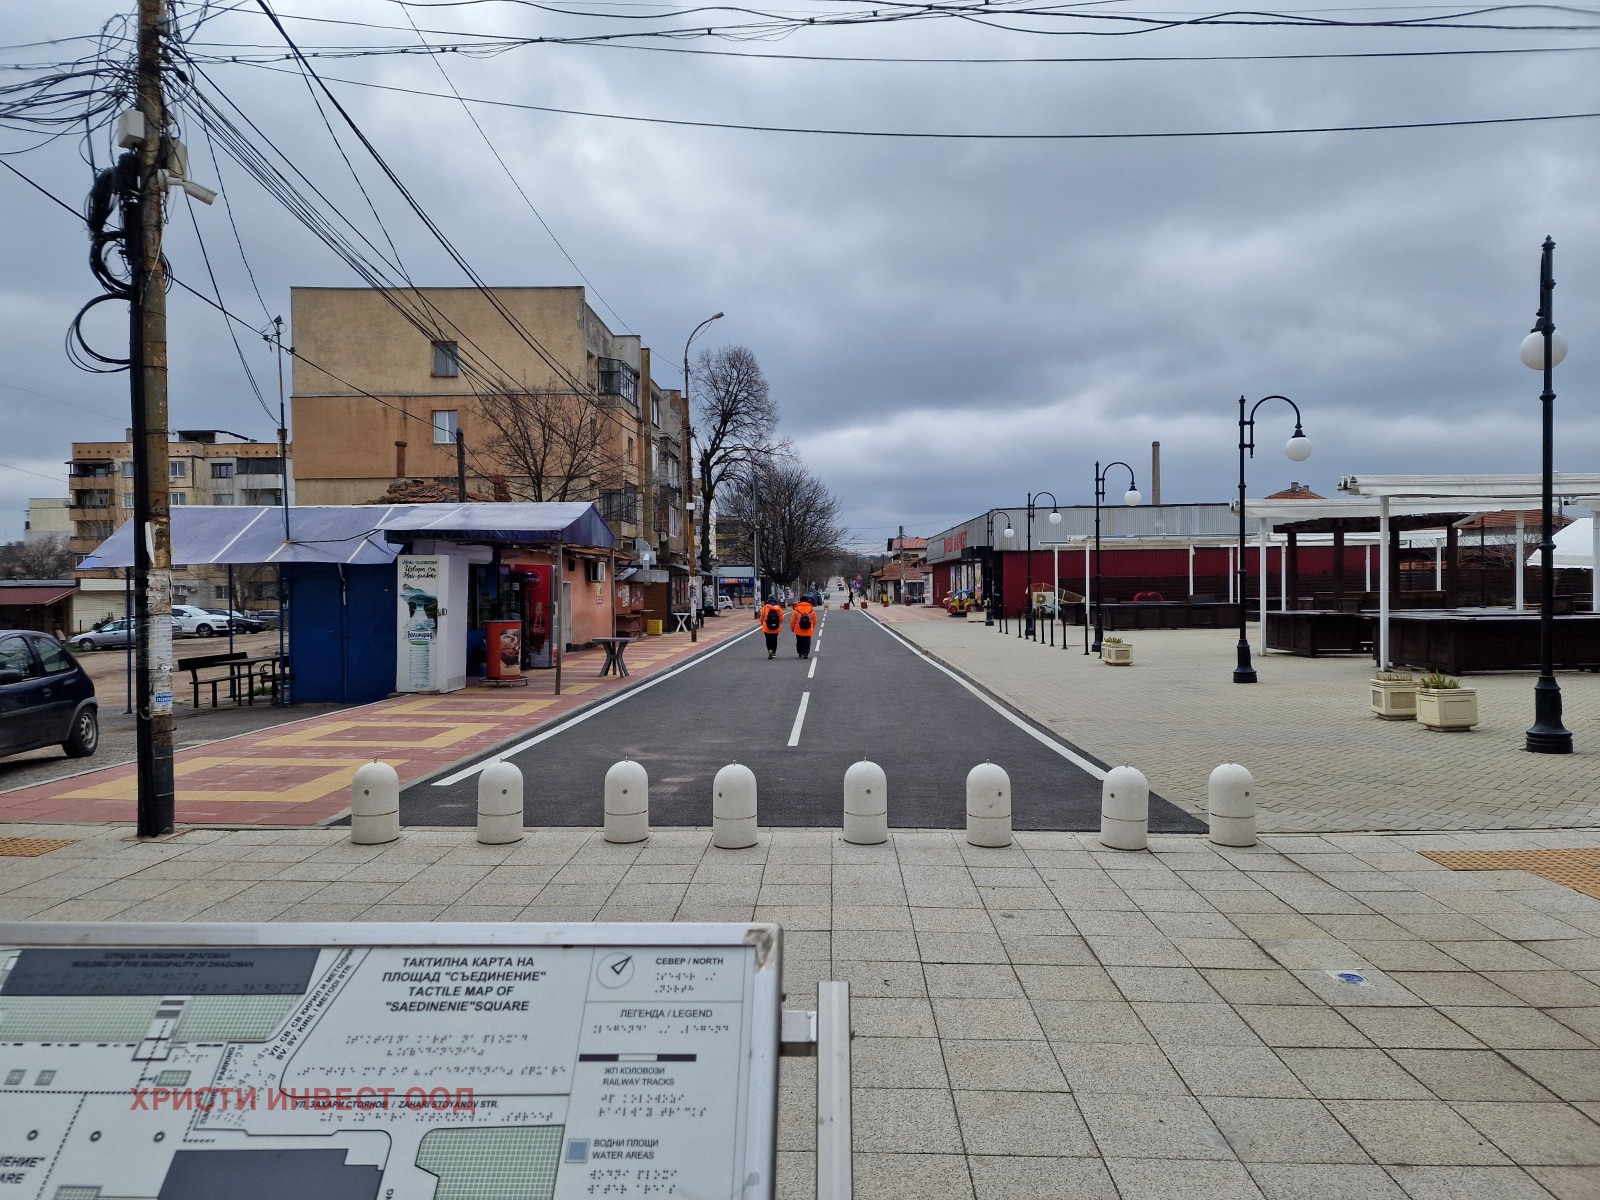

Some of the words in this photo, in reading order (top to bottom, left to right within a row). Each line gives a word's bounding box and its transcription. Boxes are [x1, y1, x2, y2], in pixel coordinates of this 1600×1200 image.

[111, 960, 123, 968] OF
[124, 960, 139, 968] THE
[195, 960, 207, 968] OF
[208, 960, 255, 968] DRAGOMAN
[402, 956, 468, 968] ТАКТИЛНА
[471, 956, 512, 968] КАРТА
[516, 956, 535, 967] НА
[655, 957, 687, 966] СЕВЕР
[692, 957, 724, 966] NORTH
[382, 971, 441, 984] ПЛОЩАД
[444, 970, 547, 983] "СЪЕДИНЕНИЕ"
[408, 985, 462, 997] TACTILE
[464, 985, 494, 997] MAP
[496, 985, 515, 997] OF
[297, 1013, 316, 1033] KIRIL
[316, 980, 340, 1009] METODI
[338, 964, 355, 980] STR.
[300, 989, 323, 1016] КИРИЛ
[319, 983, 328, 991] И
[619, 1008, 666, 1019] ЛЕГЕНДА
[672, 1008, 713, 1019] LEGEND
[216, 1046, 236, 1081] PARKING
[604, 1066, 618, 1075] ЖП
[620, 1066, 666, 1075] КОЛОВОЗИ
[602, 1077, 640, 1086] RAILWAY
[642, 1077, 675, 1086] TRACKS
[309, 1100, 345, 1109] ЗАХАРИ
[345, 1100, 388, 1109] СТОЯНОВ
[397, 1100, 431, 1108] ZAHARI
[431, 1100, 479, 1108] STOYANOV
[479, 1100, 499, 1108] STR.
[593, 1138, 625, 1148] ВОДНИ
[626, 1138, 659, 1149] ПЛОЩИ
[592, 1150, 624, 1160] WATER
[625, 1150, 655, 1160] AREAS
[0, 1172, 26, 1184] ARE
